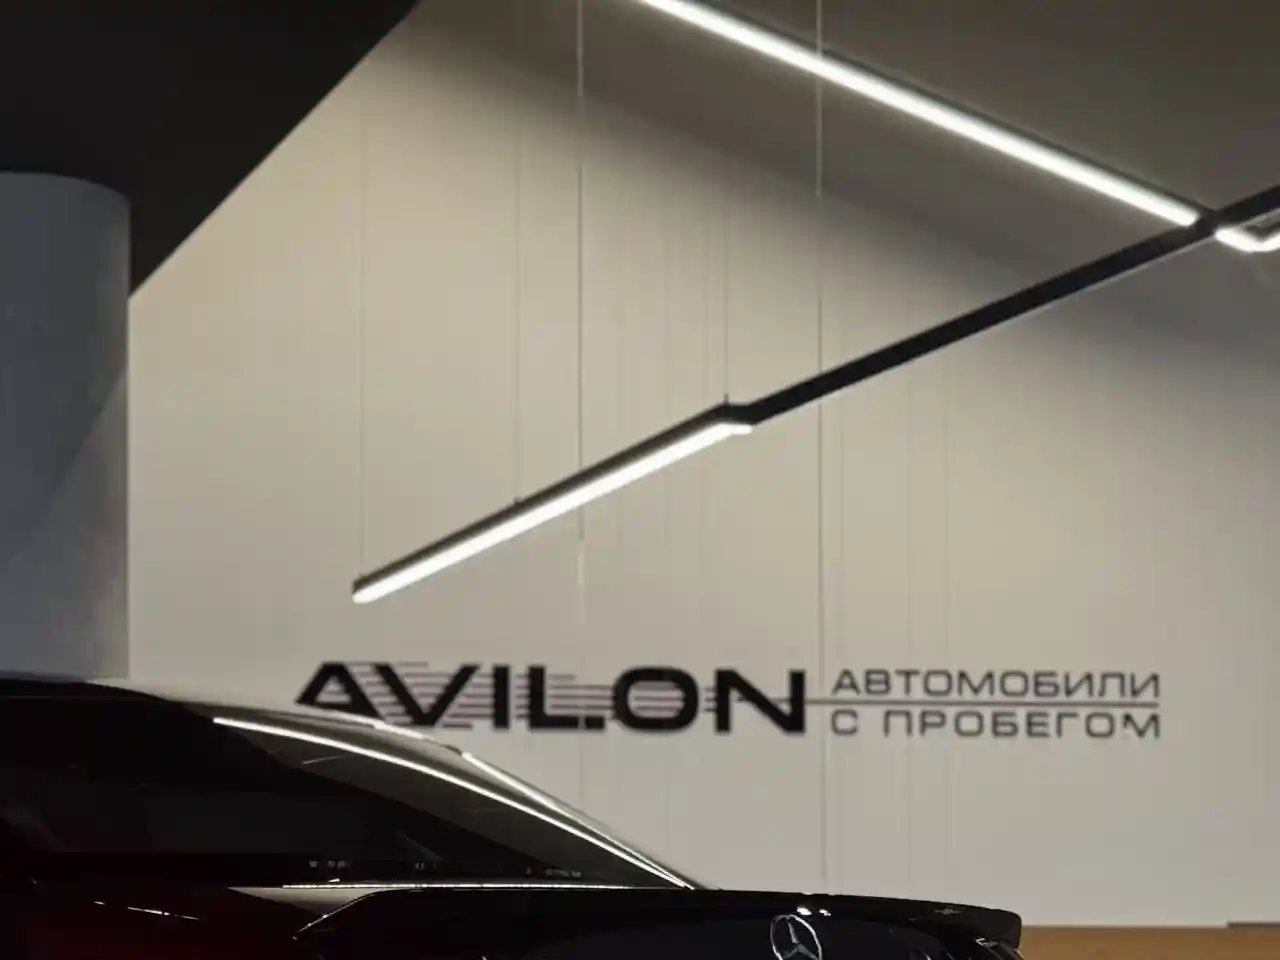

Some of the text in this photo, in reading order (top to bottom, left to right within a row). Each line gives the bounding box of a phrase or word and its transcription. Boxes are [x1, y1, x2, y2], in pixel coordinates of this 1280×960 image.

[295, 661, 807, 734] AVILON
[832, 668, 1161, 699] АВТОМОБИЛИ
[831, 709, 1161, 738] С ПРОБЕГОМ
